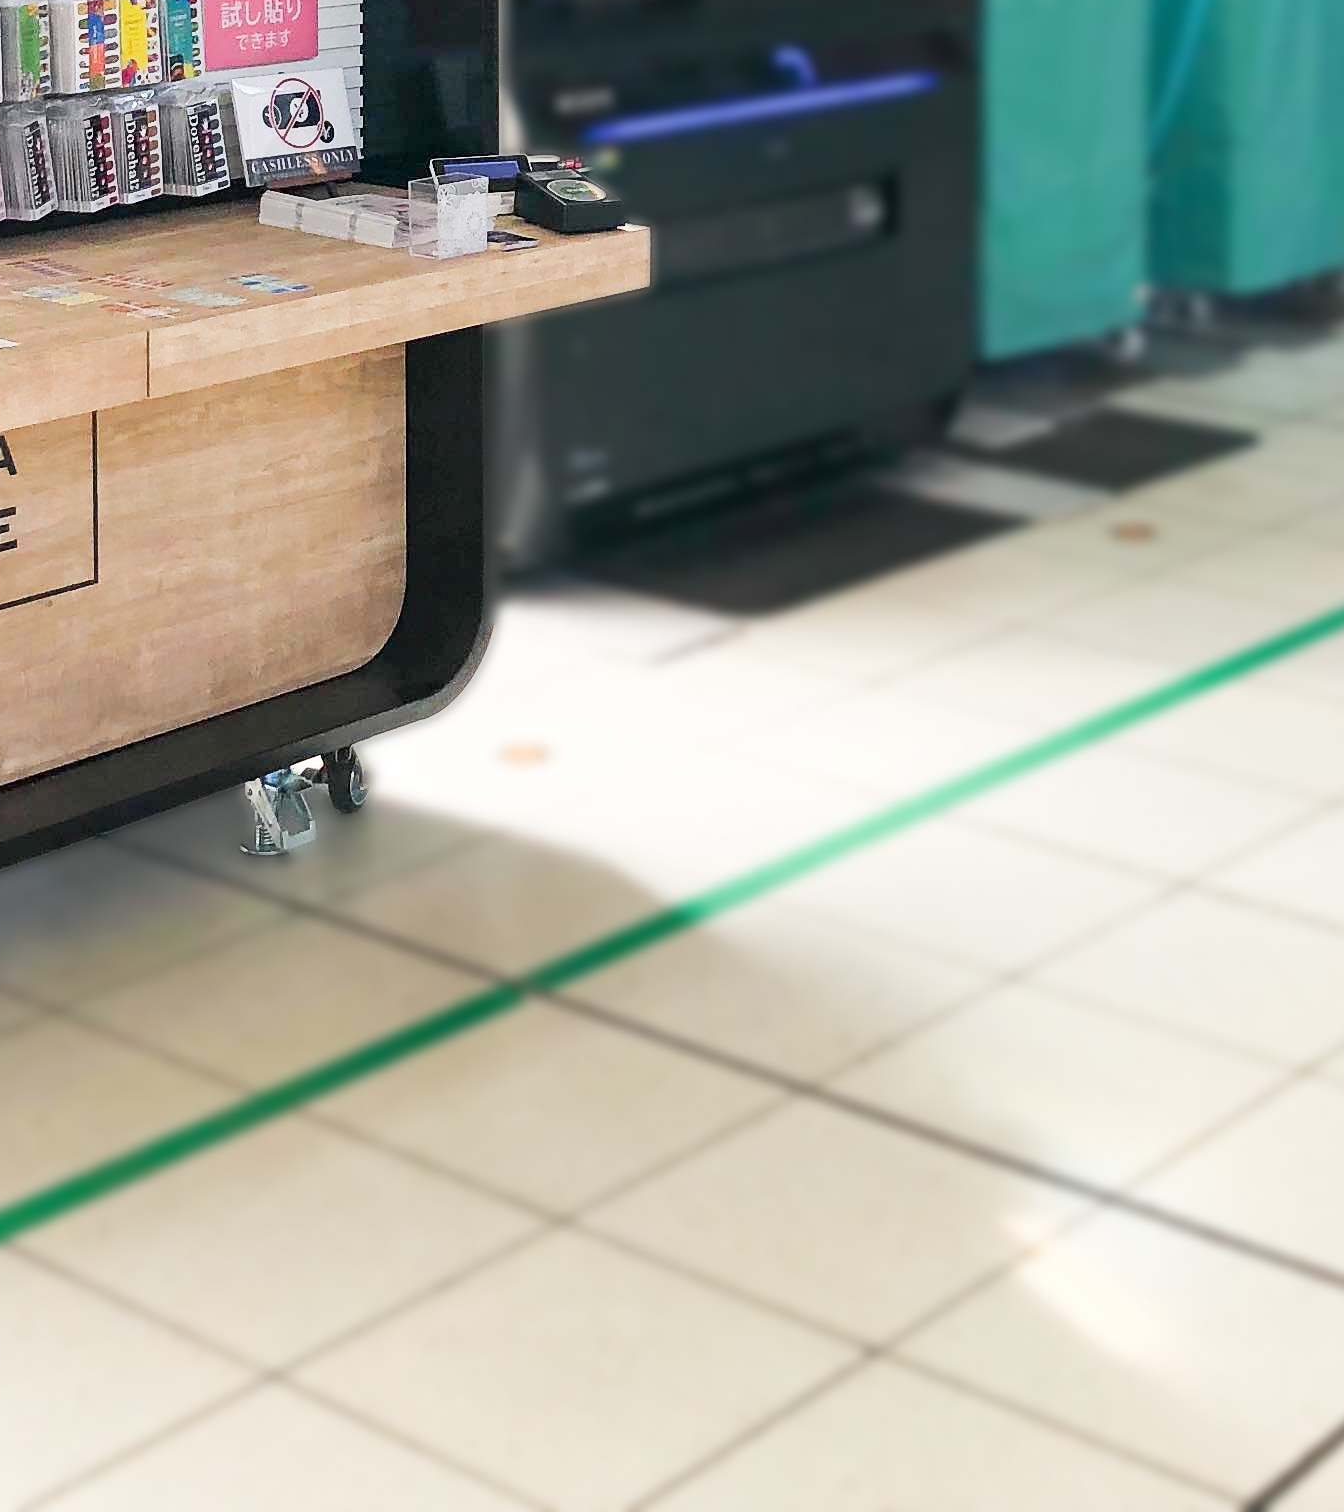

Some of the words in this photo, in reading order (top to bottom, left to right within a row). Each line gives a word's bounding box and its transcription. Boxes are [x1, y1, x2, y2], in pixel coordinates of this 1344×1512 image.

[235, 29, 291, 50] できます
[251, 154, 319, 174] CASHLESS
[322, 149, 354, 164] ONLY
